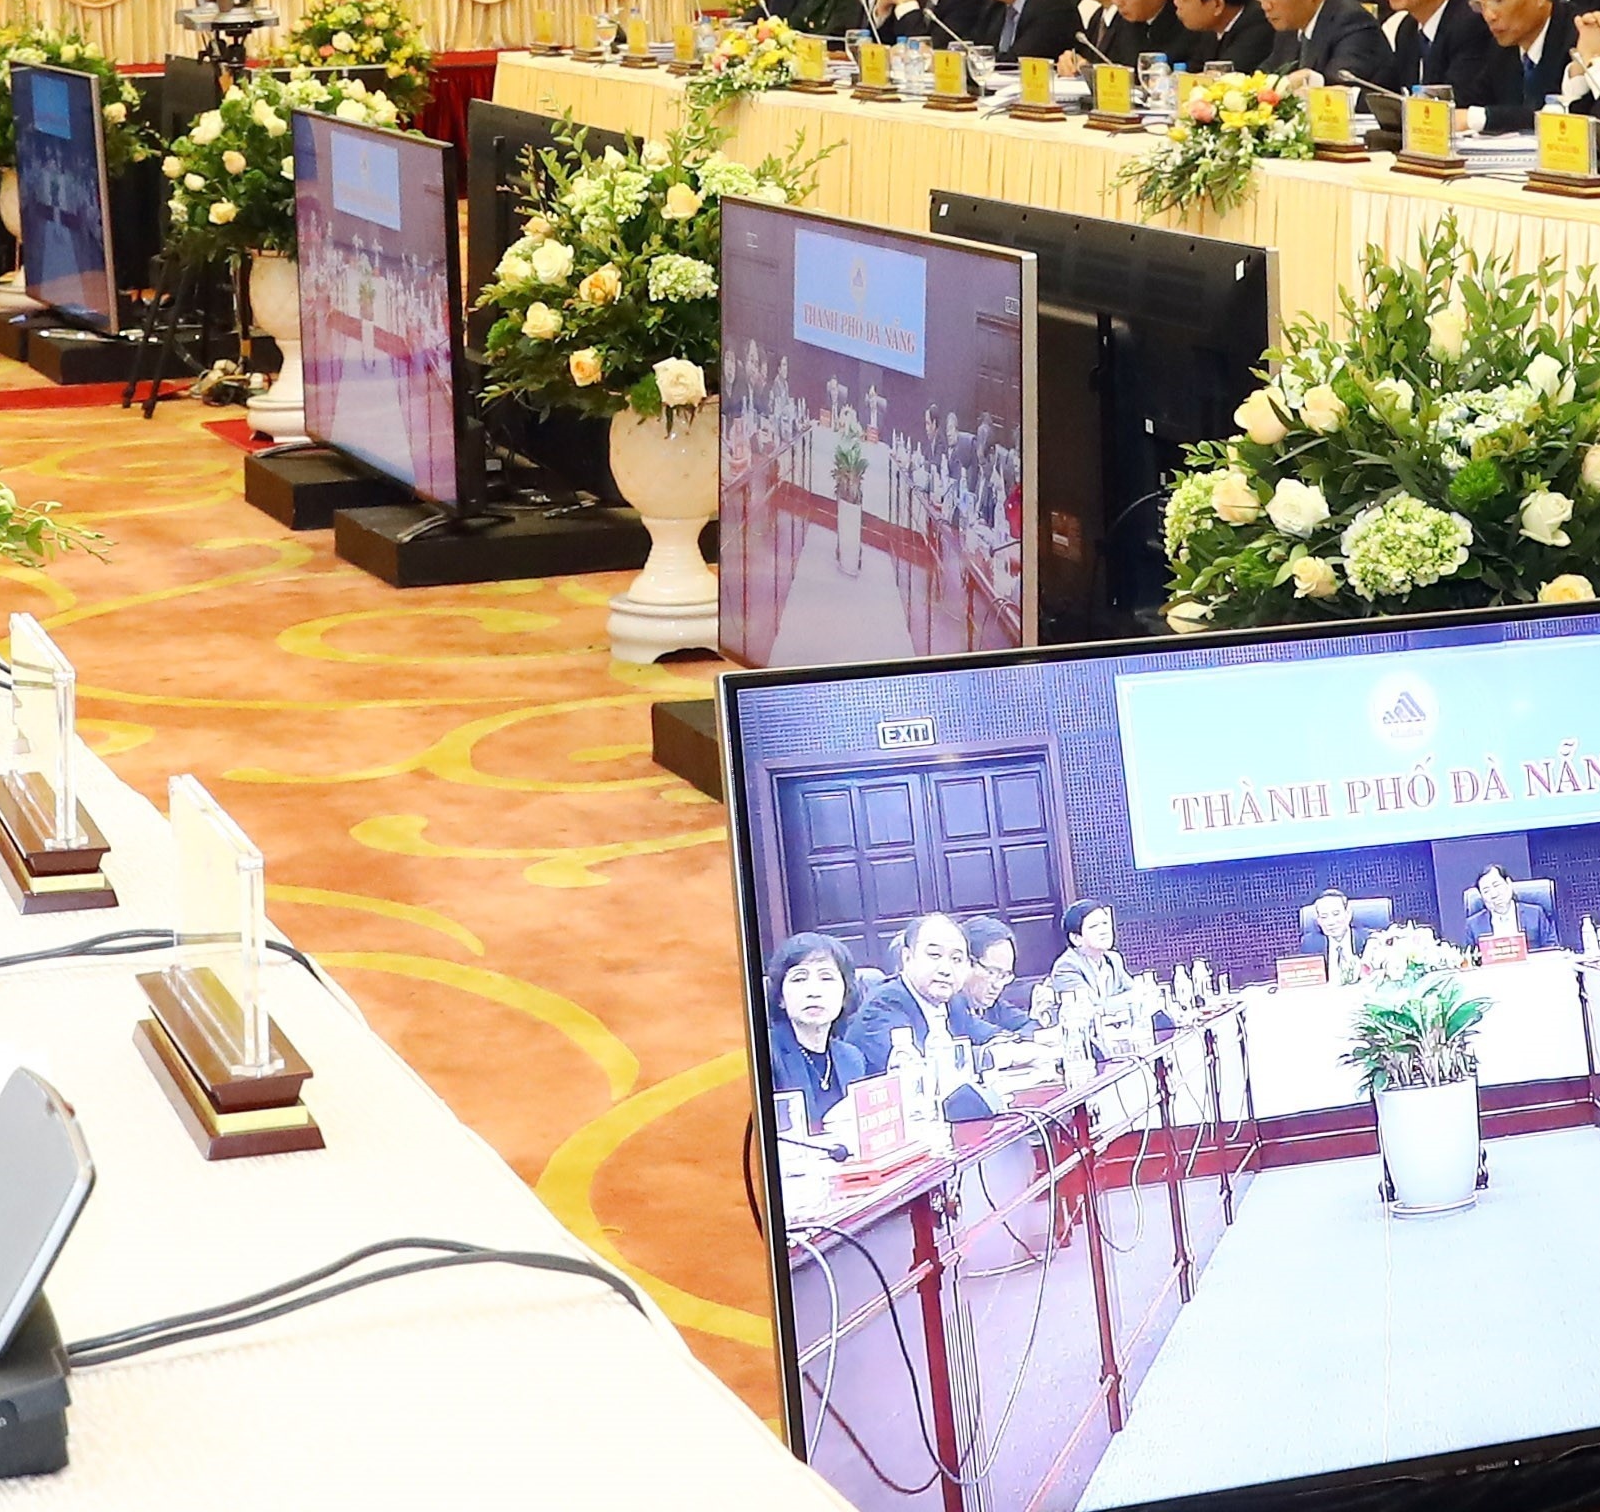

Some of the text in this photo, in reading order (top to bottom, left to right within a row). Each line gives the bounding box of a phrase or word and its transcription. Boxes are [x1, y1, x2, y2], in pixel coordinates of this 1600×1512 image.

[884, 724, 928, 744] EXIT
[1172, 778, 1331, 832] THÀNH
[1345, 755, 1436, 817] PHỐ
[1449, 756, 1510, 807] ĐÀ
